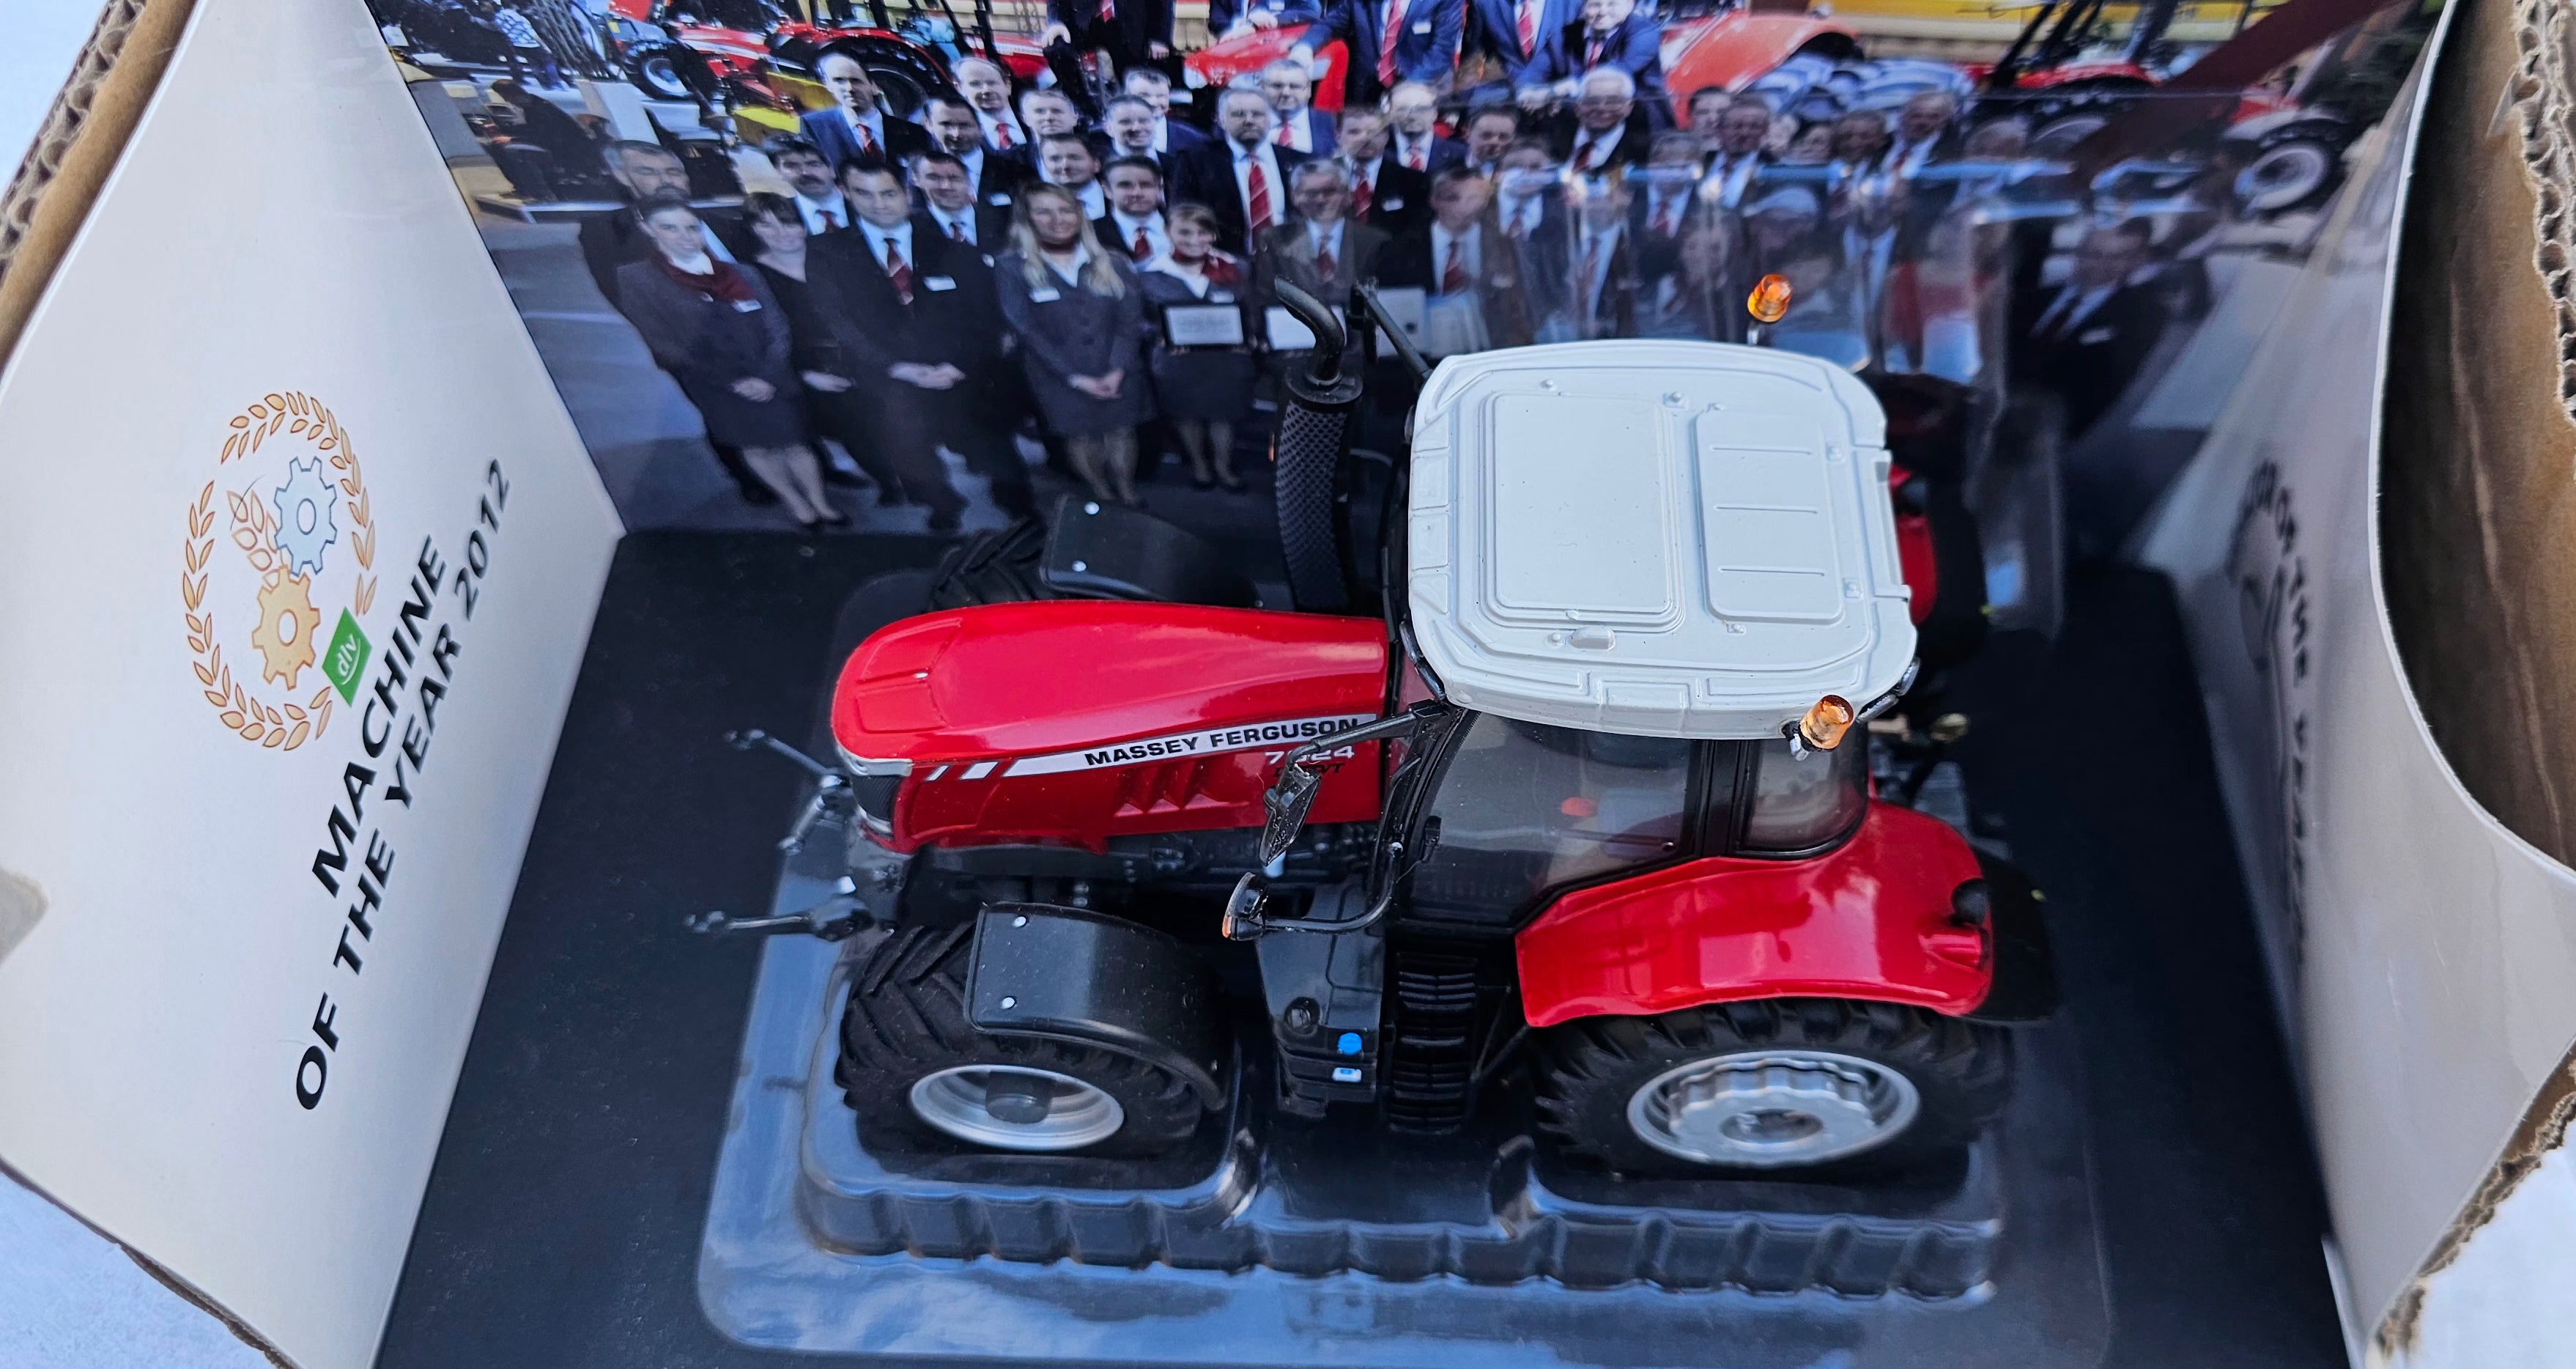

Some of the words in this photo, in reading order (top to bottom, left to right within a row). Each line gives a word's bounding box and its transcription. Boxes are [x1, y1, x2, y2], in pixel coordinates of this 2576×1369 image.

[295, 991, 339, 1111] OF
[332, 829, 395, 976] THE
[383, 623, 462, 809] YEAR
[454, 457, 511, 621] 2012
[311, 534, 445, 899] MACHINE
[1084, 736, 1199, 767] MASSEY
[1210, 717, 1358, 748] FERGUSON
